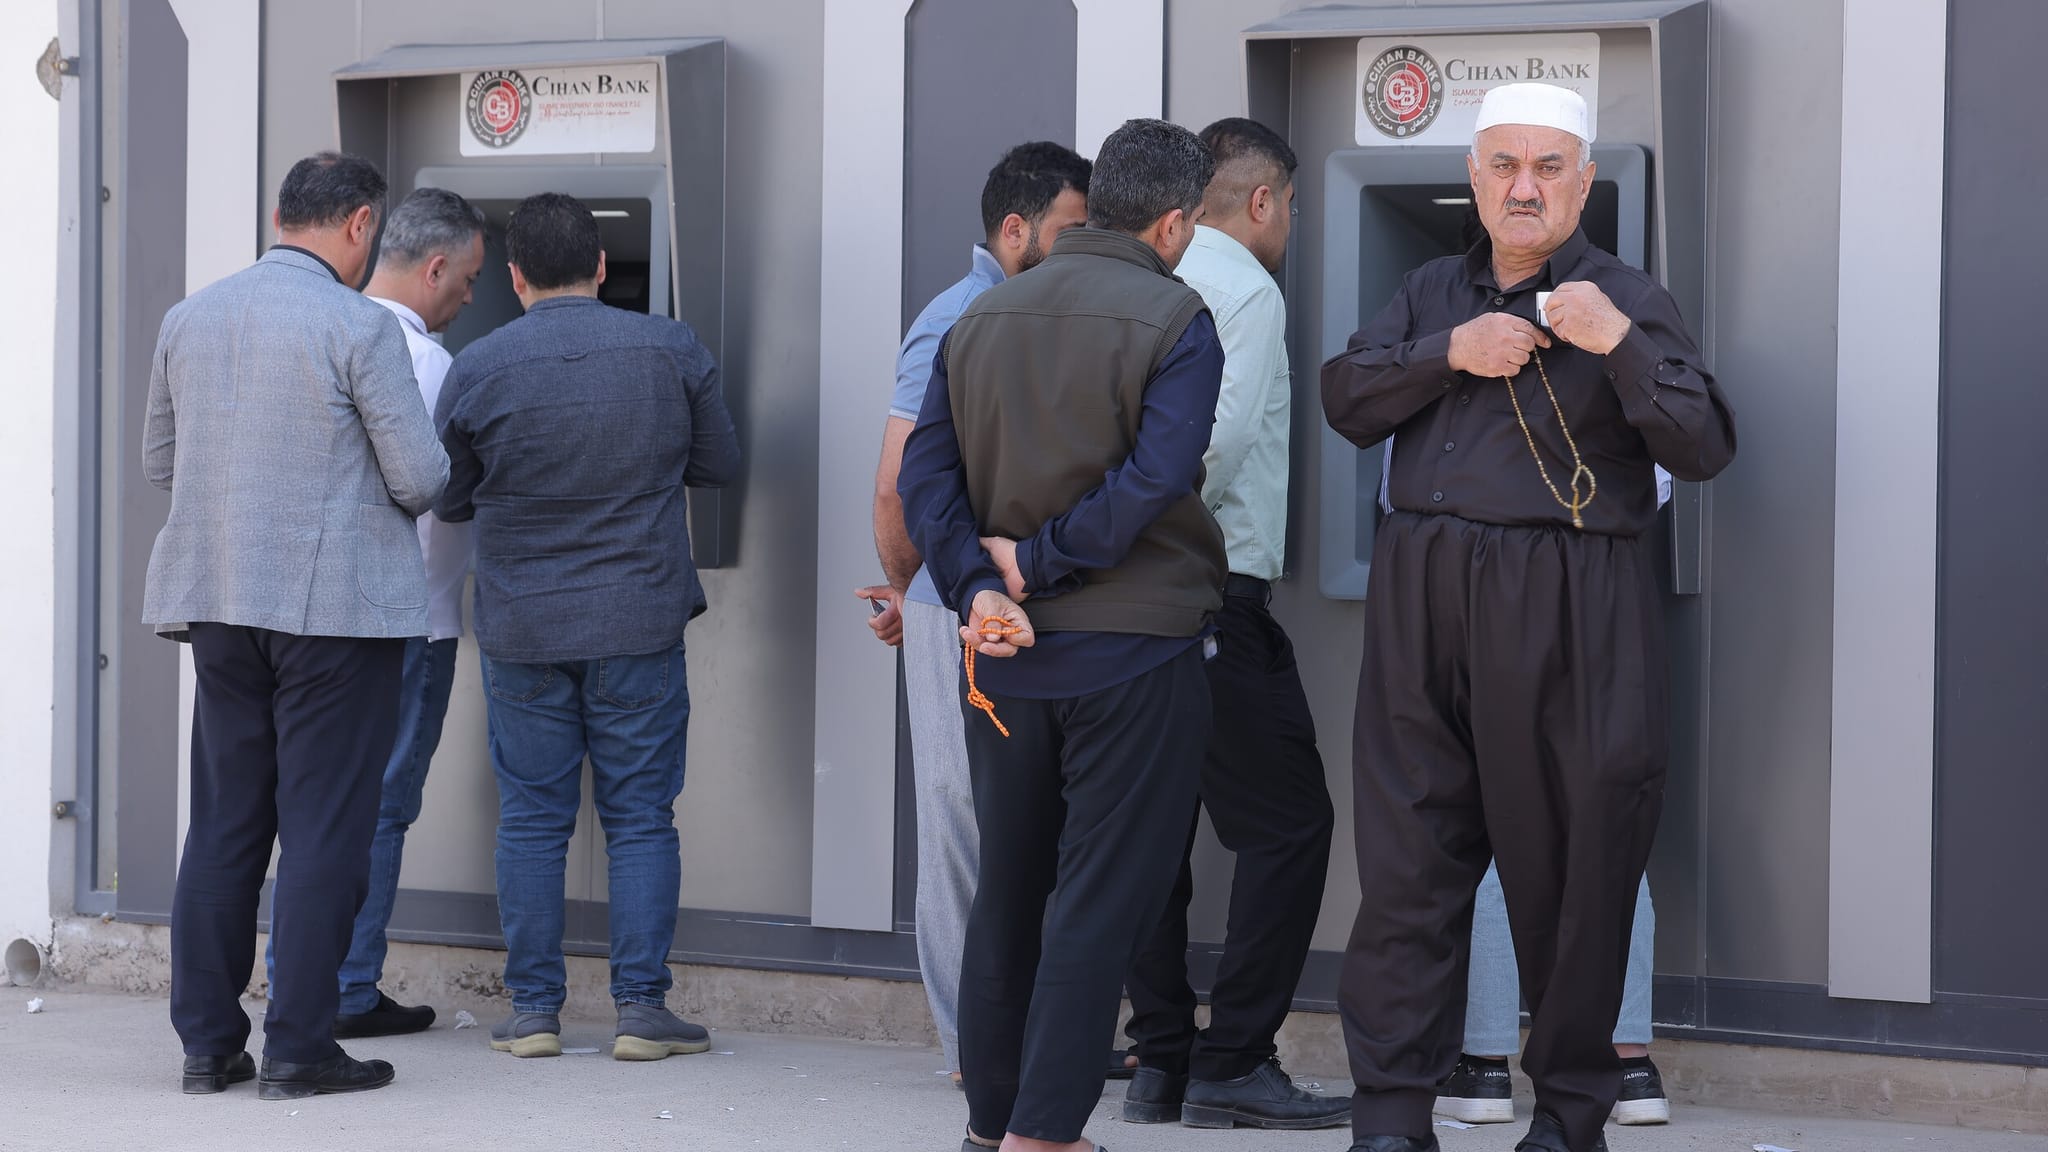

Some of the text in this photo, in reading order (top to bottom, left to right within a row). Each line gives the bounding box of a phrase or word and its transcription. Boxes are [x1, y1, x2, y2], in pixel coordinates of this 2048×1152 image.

[1369, 49, 1439, 82] CIHAN BANK
[1444, 57, 1591, 81] CIHAN BANK
[470, 70, 528, 98] CIHAN BANK
[532, 74, 650, 96] CIHAN BANK
[1452, 87, 1477, 97] ISLAMIC
[1623, 1071, 1649, 1081] FASHION
